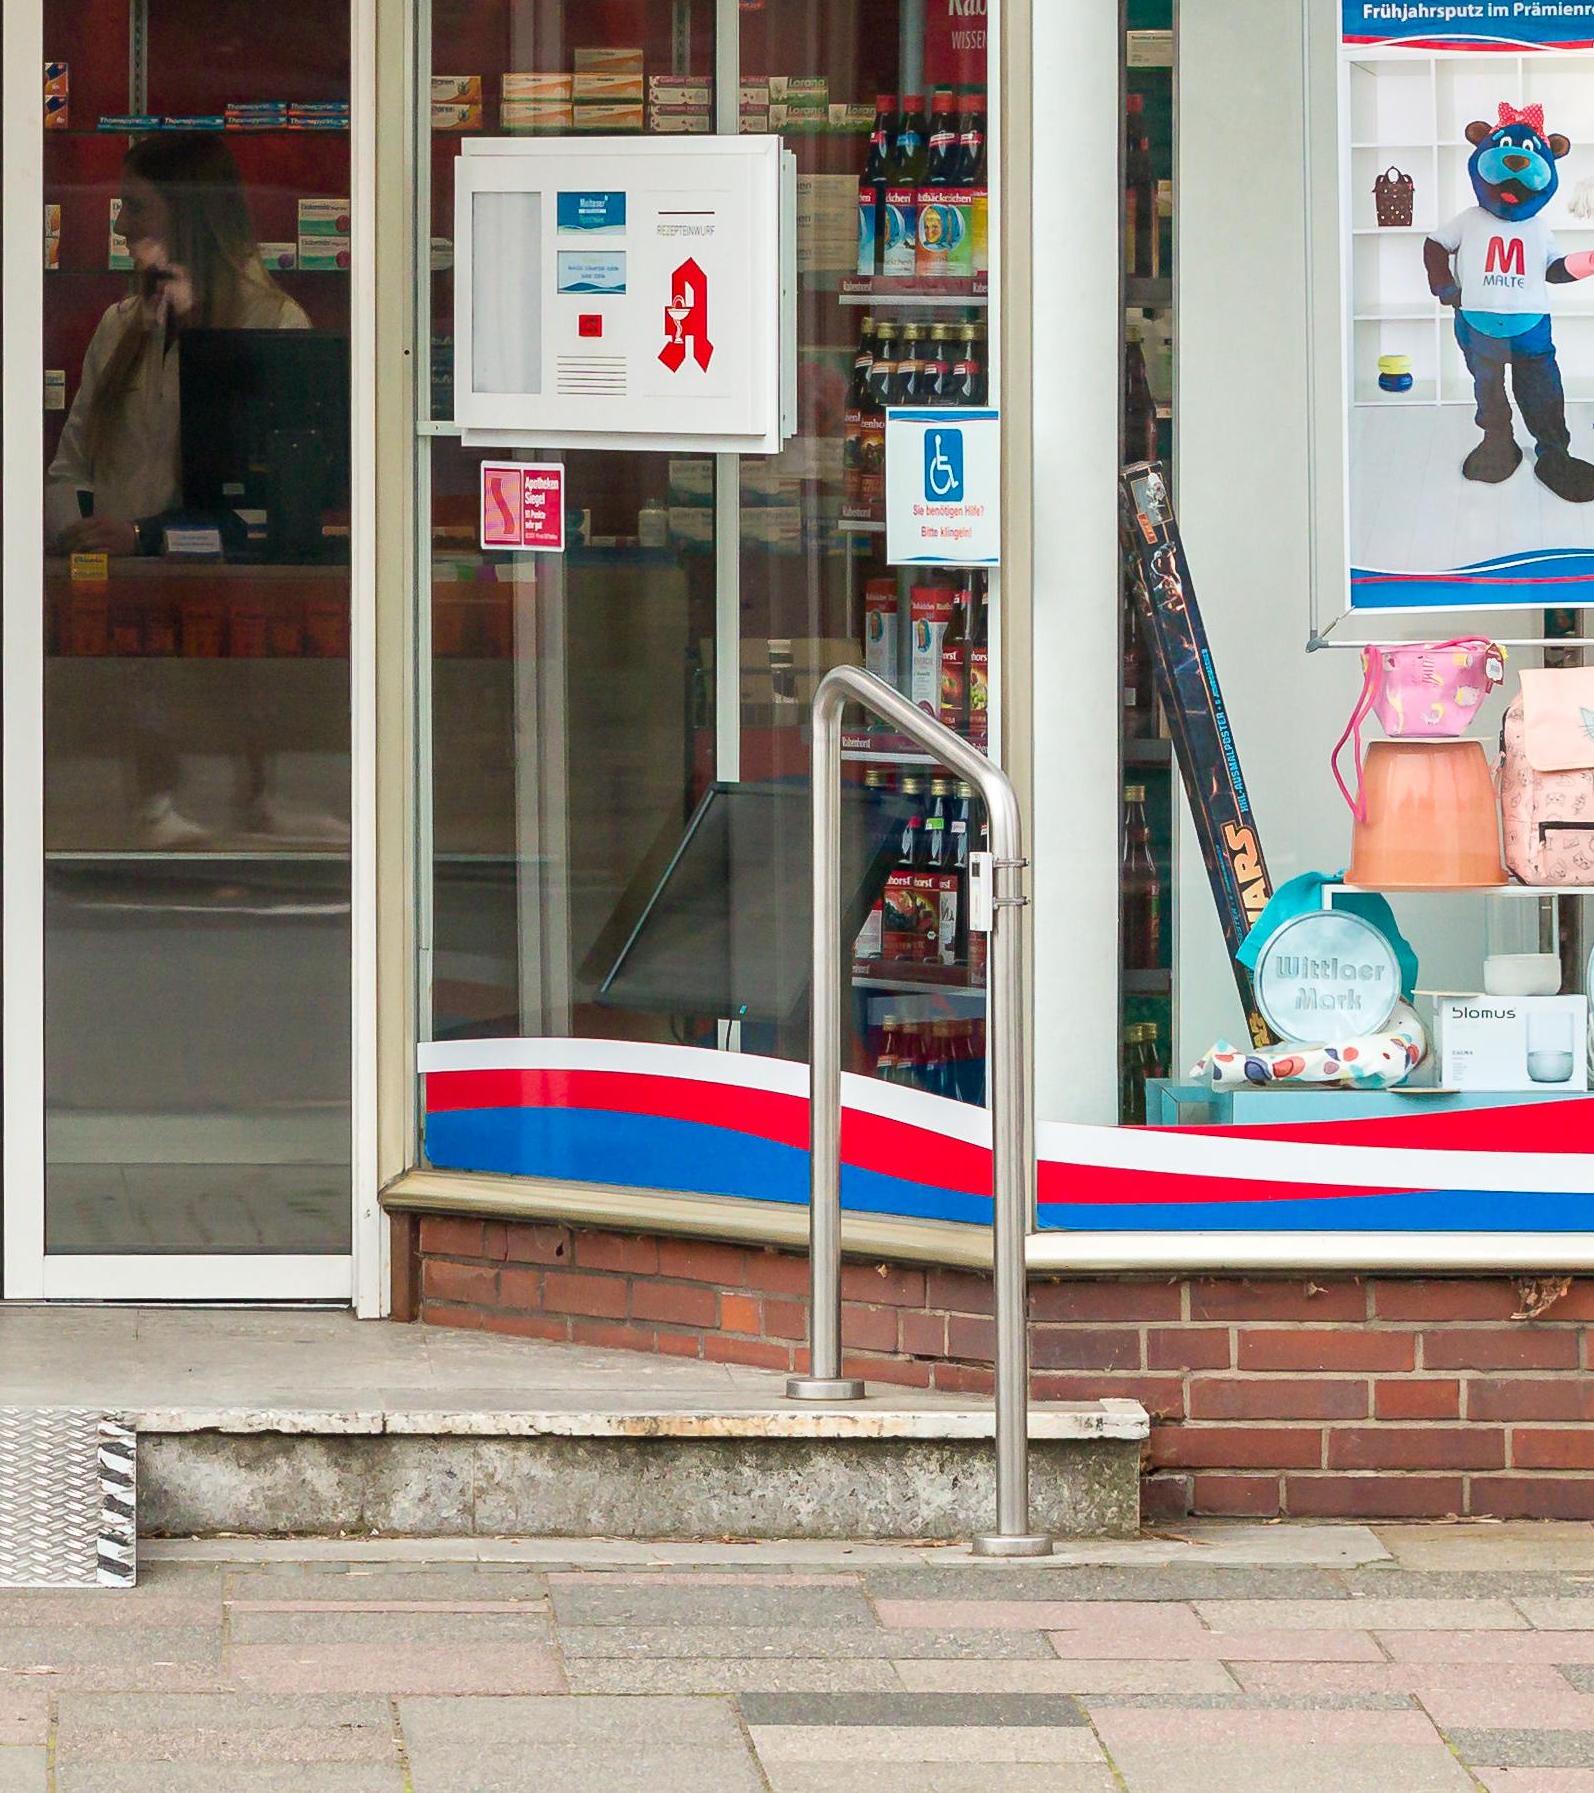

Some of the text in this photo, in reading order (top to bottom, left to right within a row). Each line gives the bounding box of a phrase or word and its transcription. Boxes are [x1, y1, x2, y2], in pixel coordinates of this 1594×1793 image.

[1362, 2, 1484, 22] Frühjahrsputz
[1487, 1, 1510, 18] im
[656, 225, 715, 237] REZEPTEINWURF
[1485, 236, 1526, 276] M
[1482, 273, 1526, 290] MALTE
[912, 503, 985, 518] Sie benötigen Hilfe?
[921, 525, 973, 540] Bitte klingeln!
[1275, 955, 1386, 981] Wittlaer
[1294, 987, 1362, 1011] Mark
[1451, 1006, 1516, 1020] blomus
